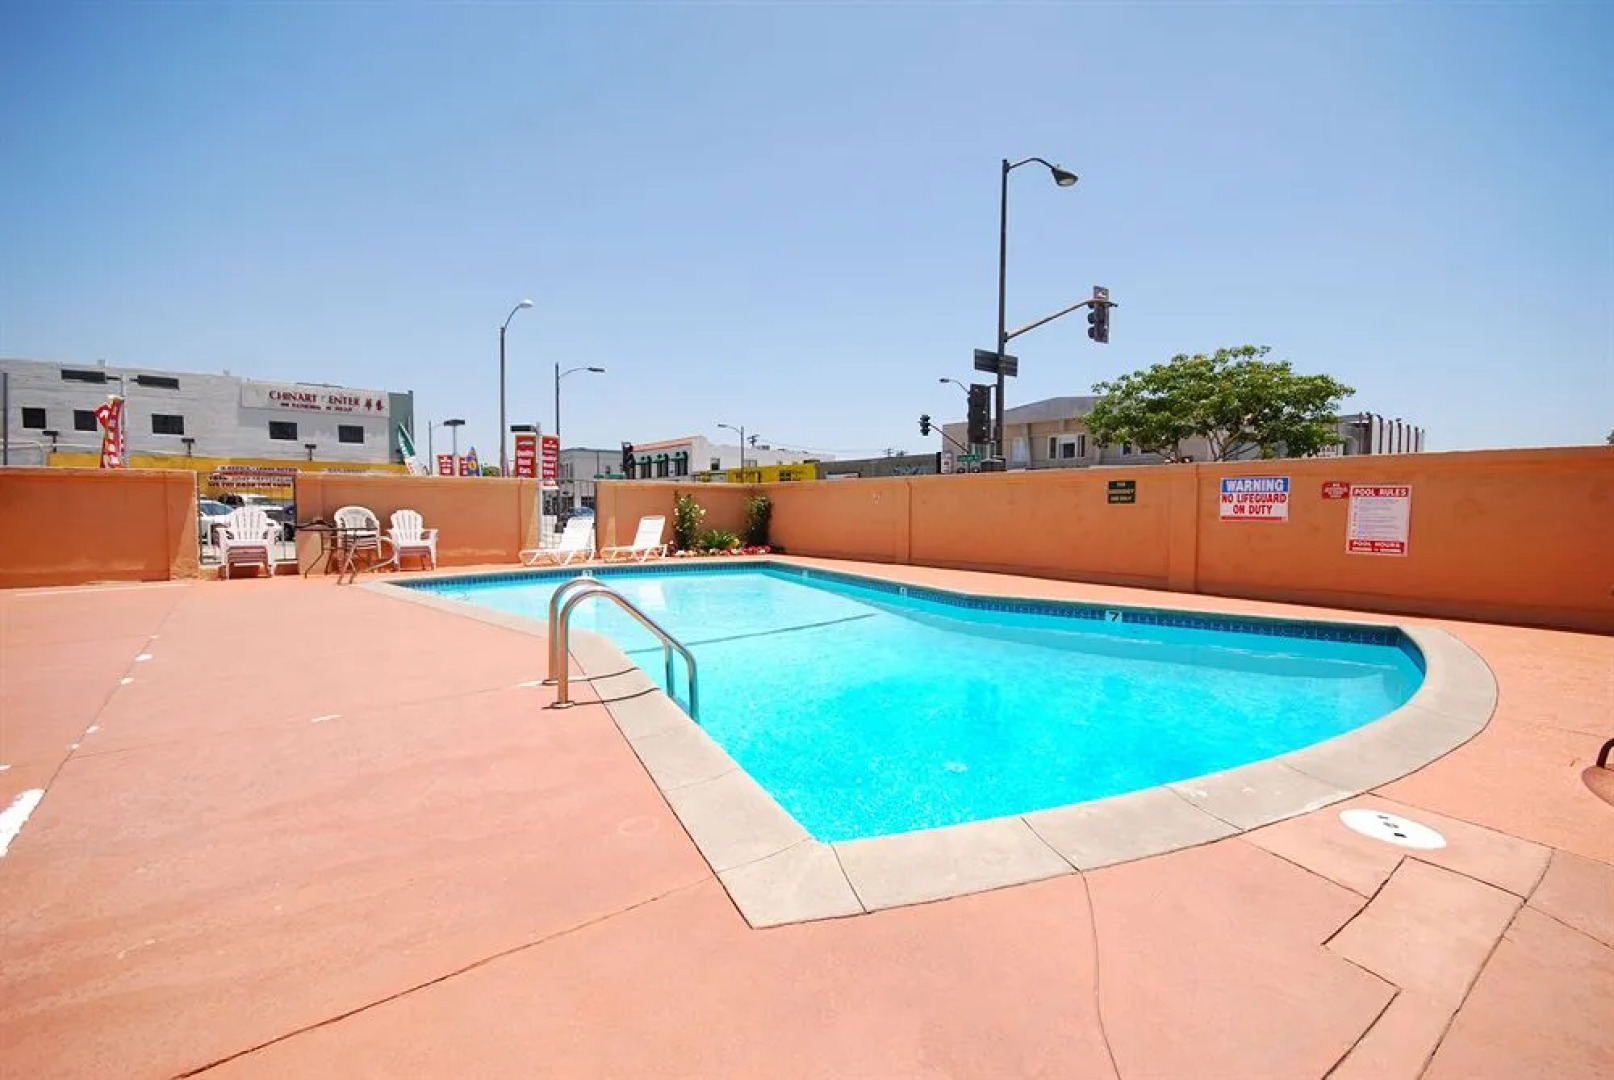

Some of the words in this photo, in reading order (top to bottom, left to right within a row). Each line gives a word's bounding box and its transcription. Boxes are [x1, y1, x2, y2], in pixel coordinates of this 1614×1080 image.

[1226, 478, 1284, 492] WARNING
[1354, 488, 1376, 497] POOL
[1379, 488, 1407, 497] RULES
[1221, 493, 1234, 503] NO
[1236, 493, 1287, 503] LIFEGUARD
[1232, 504, 1245, 514] ON
[1249, 504, 1273, 514] DUTY
[1109, 611, 1119, 622] 7
